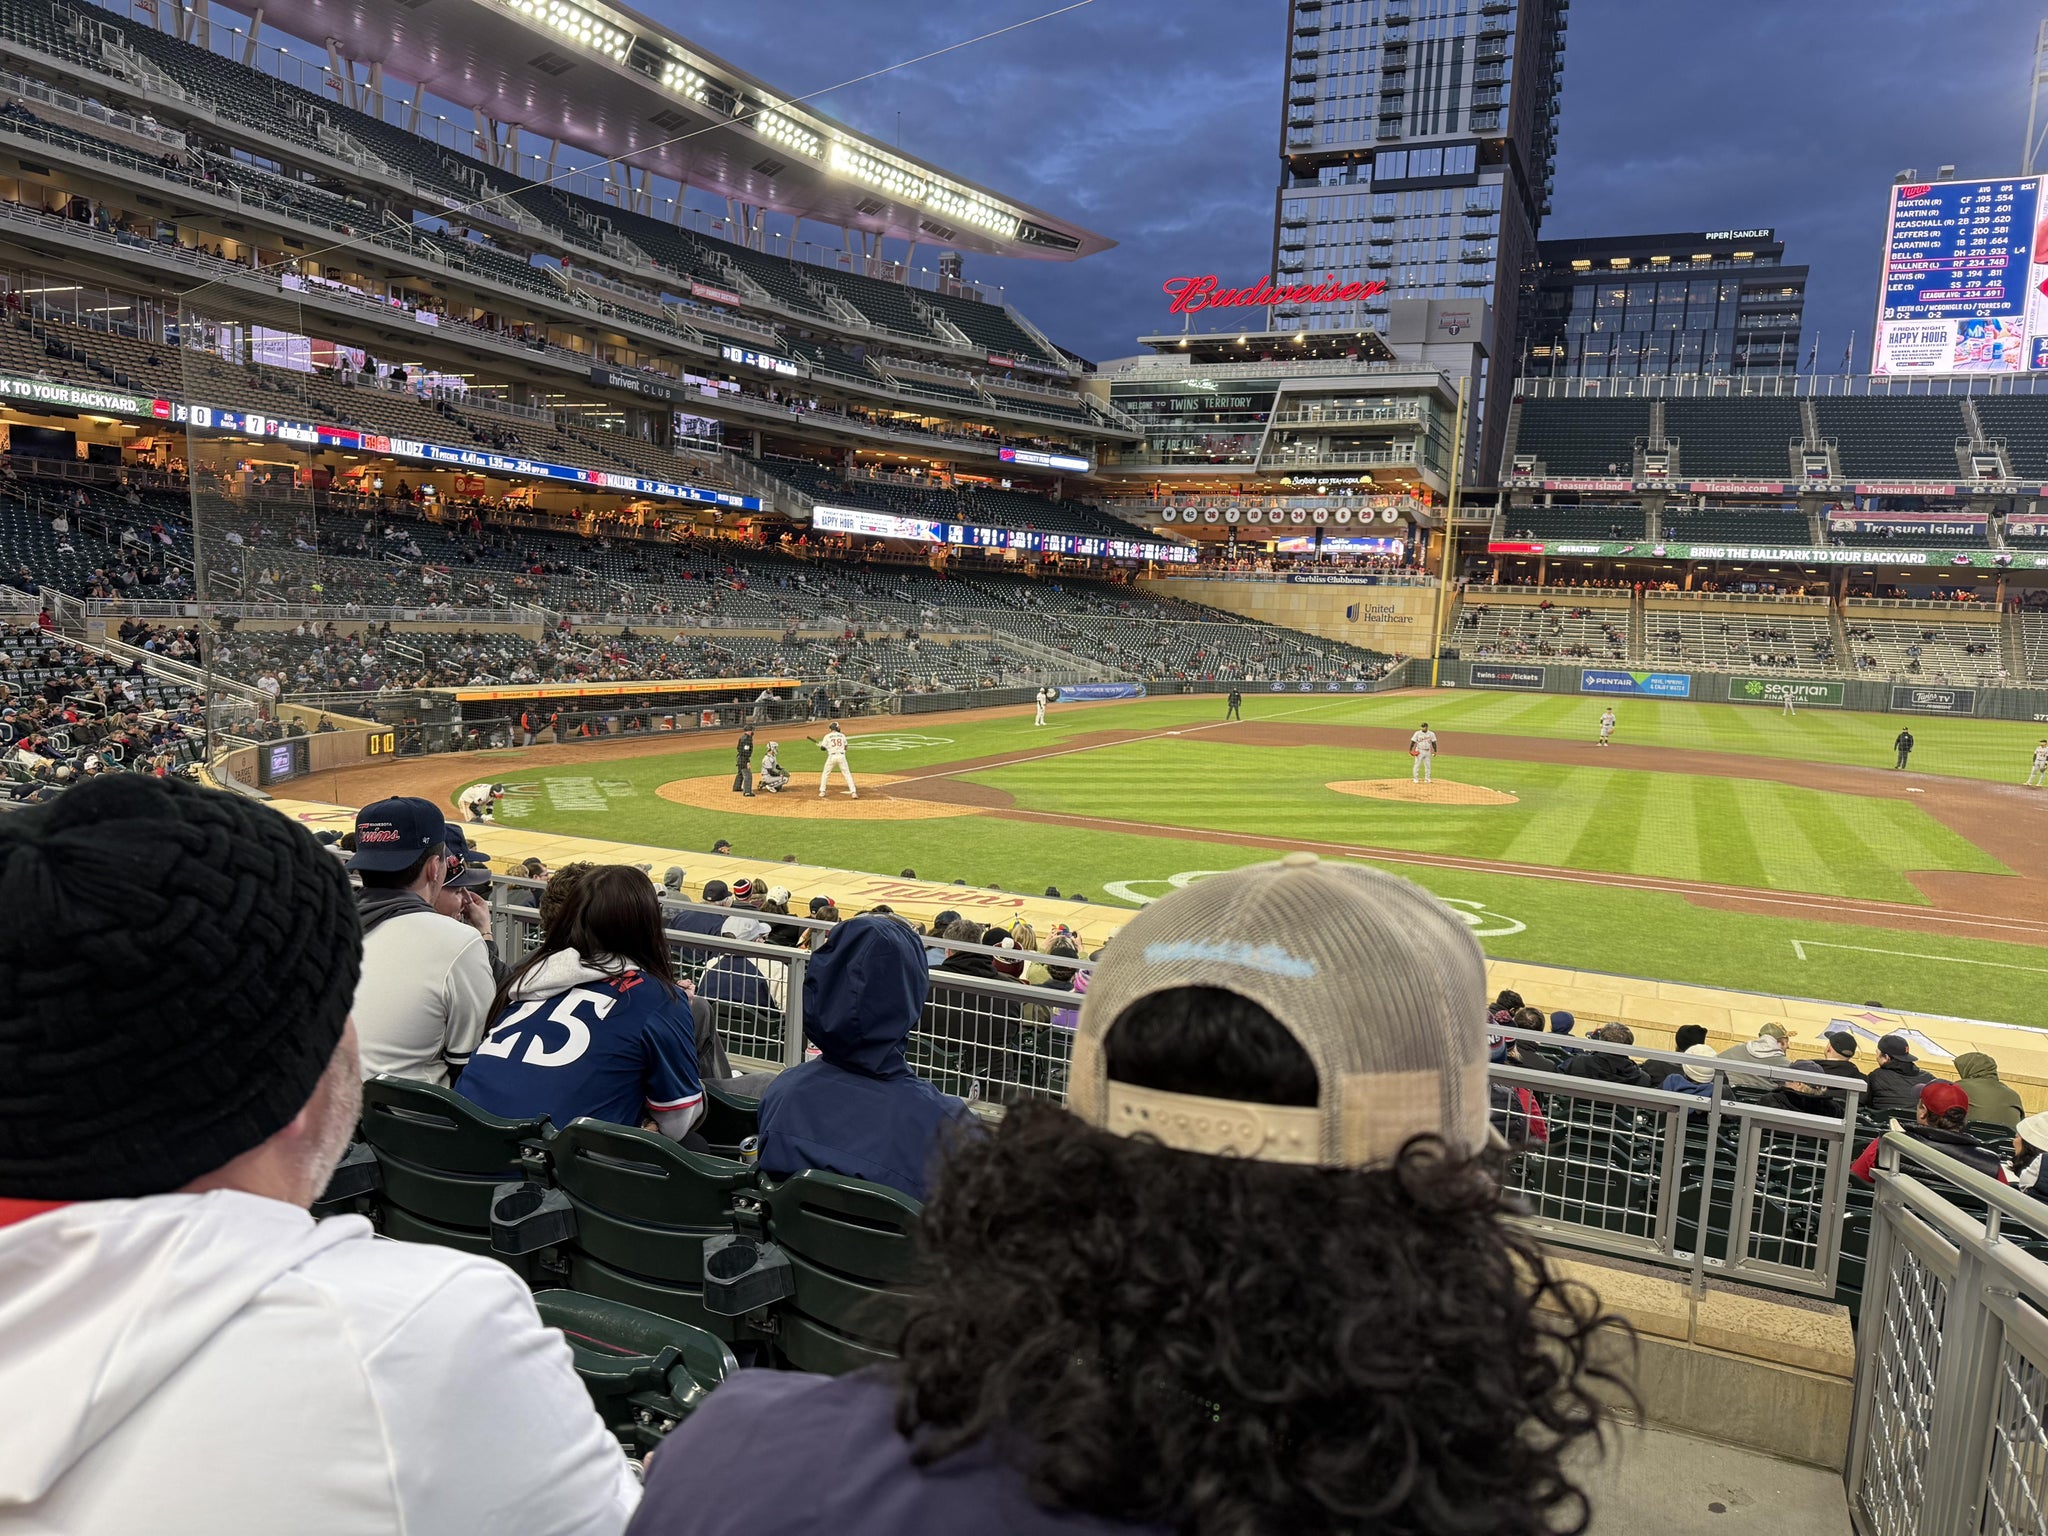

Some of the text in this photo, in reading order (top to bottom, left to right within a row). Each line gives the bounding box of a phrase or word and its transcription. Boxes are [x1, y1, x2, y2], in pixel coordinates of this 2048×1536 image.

[1898, 199, 1930, 208] BUXTON
[1896, 210, 1928, 218] MARTIN
[1895, 220, 1943, 228] KEASCHALL
[1733, 230, 1769, 238] SANDLER
[1894, 230, 1928, 239] JEFFERS
[1892, 241, 1930, 249] CARATINI
[1890, 262, 1928, 270] WALLNER
[1162, 274, 1387, 314] Budweiser
[1889, 331, 1948, 344] HAPPY HOUR
[608, 373, 670, 398] thrivent CLUB
[13, 382, 31, 396] TO
[32, 384, 69, 402] YOUR
[72, 390, 140, 412] BACKYARD.
[1128, 401, 1153, 410] WELCOME
[1170, 398, 1199, 410] TWINS
[1205, 397, 1252, 408] TERRITORY
[197, 408, 258, 432] 0 7
[1153, 440, 1165, 450] WE
[1167, 440, 1180, 450] ARE
[390, 438, 424, 456] VALDEZ
[606, 473, 638, 490] WALLNER
[1554, 482, 1623, 490] Treasure Island
[1866, 486, 1945, 495] Treasure Island
[822, 516, 838, 527] HAPPY
[840, 517, 854, 529] HOUR
[1930, 524, 1974, 534] Island
[1690, 547, 1926, 564] BRING THE BALLPARK TO YOUR BACKYARD
[1294, 575, 1368, 584] Carbliss Clubhouse
[1364, 604, 1395, 613] United
[1364, 613, 1413, 623] Healthcare
[1477, 672, 1538, 681] twins.com/tickets
[1596, 678, 1632, 686] PENTAIR
[1765, 683, 1828, 696] securian
[1764, 693, 1808, 702] FINAIAL
[831, 738, 842, 747] 38
[235, 766, 253, 778] TARGET
[358, 823, 400, 843] Twins
[852, 881, 1024, 908] Twins
[476, 988, 618, 1067] 25
